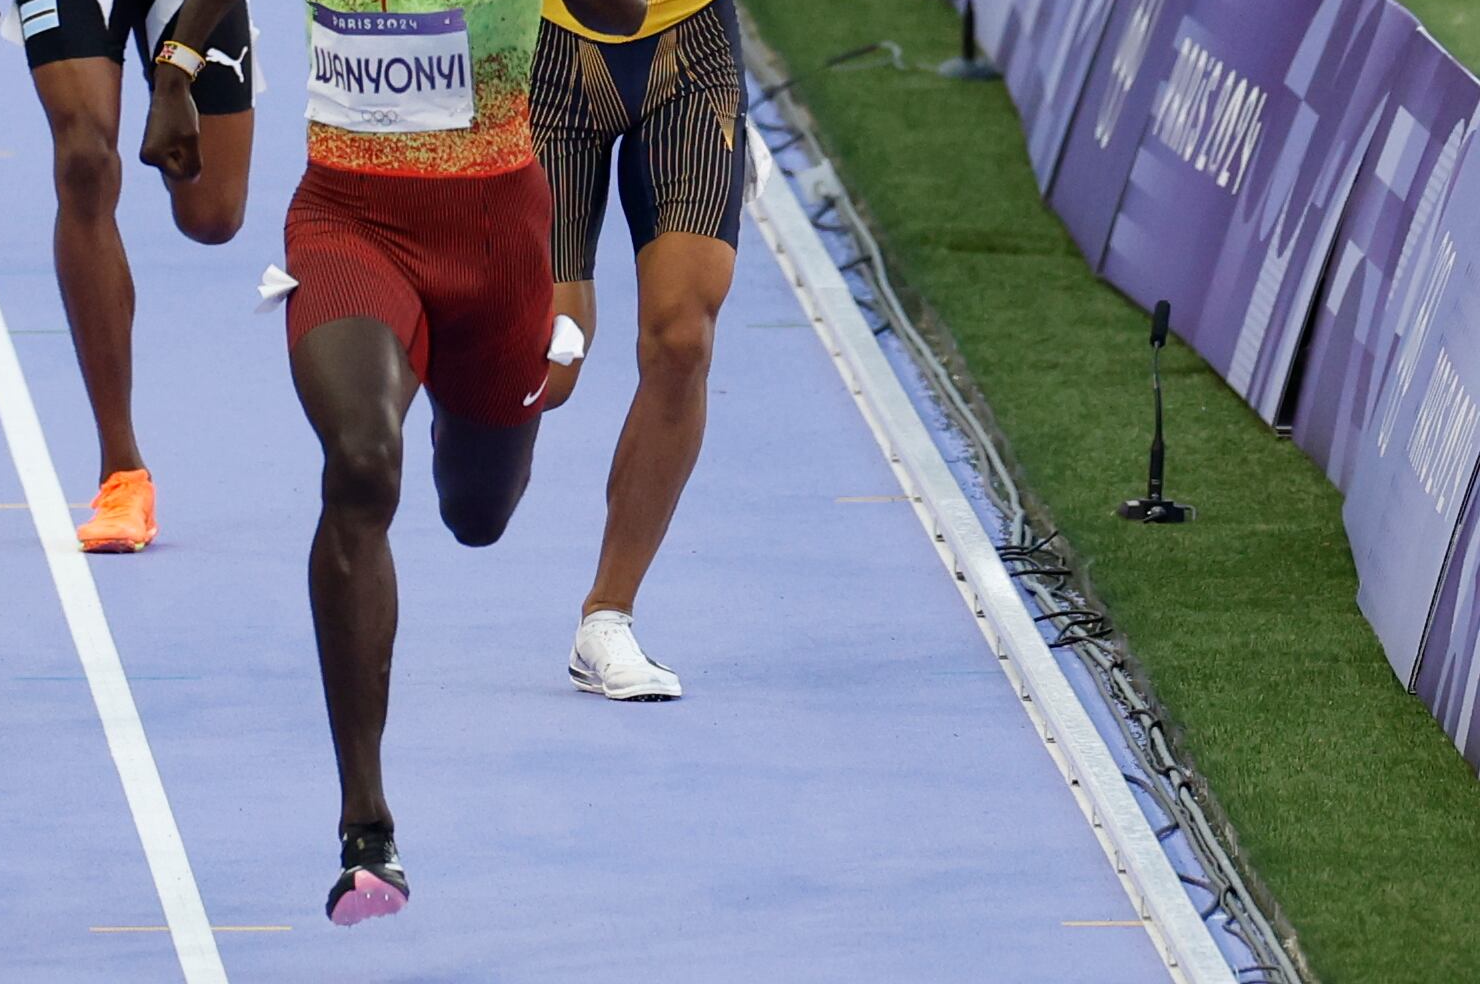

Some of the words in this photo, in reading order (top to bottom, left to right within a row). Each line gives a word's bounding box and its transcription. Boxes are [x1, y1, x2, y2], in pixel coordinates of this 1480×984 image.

[332, 15, 372, 30] PARIS
[376, 19, 418, 30] 2024
[314, 45, 466, 94] WANYONYI
